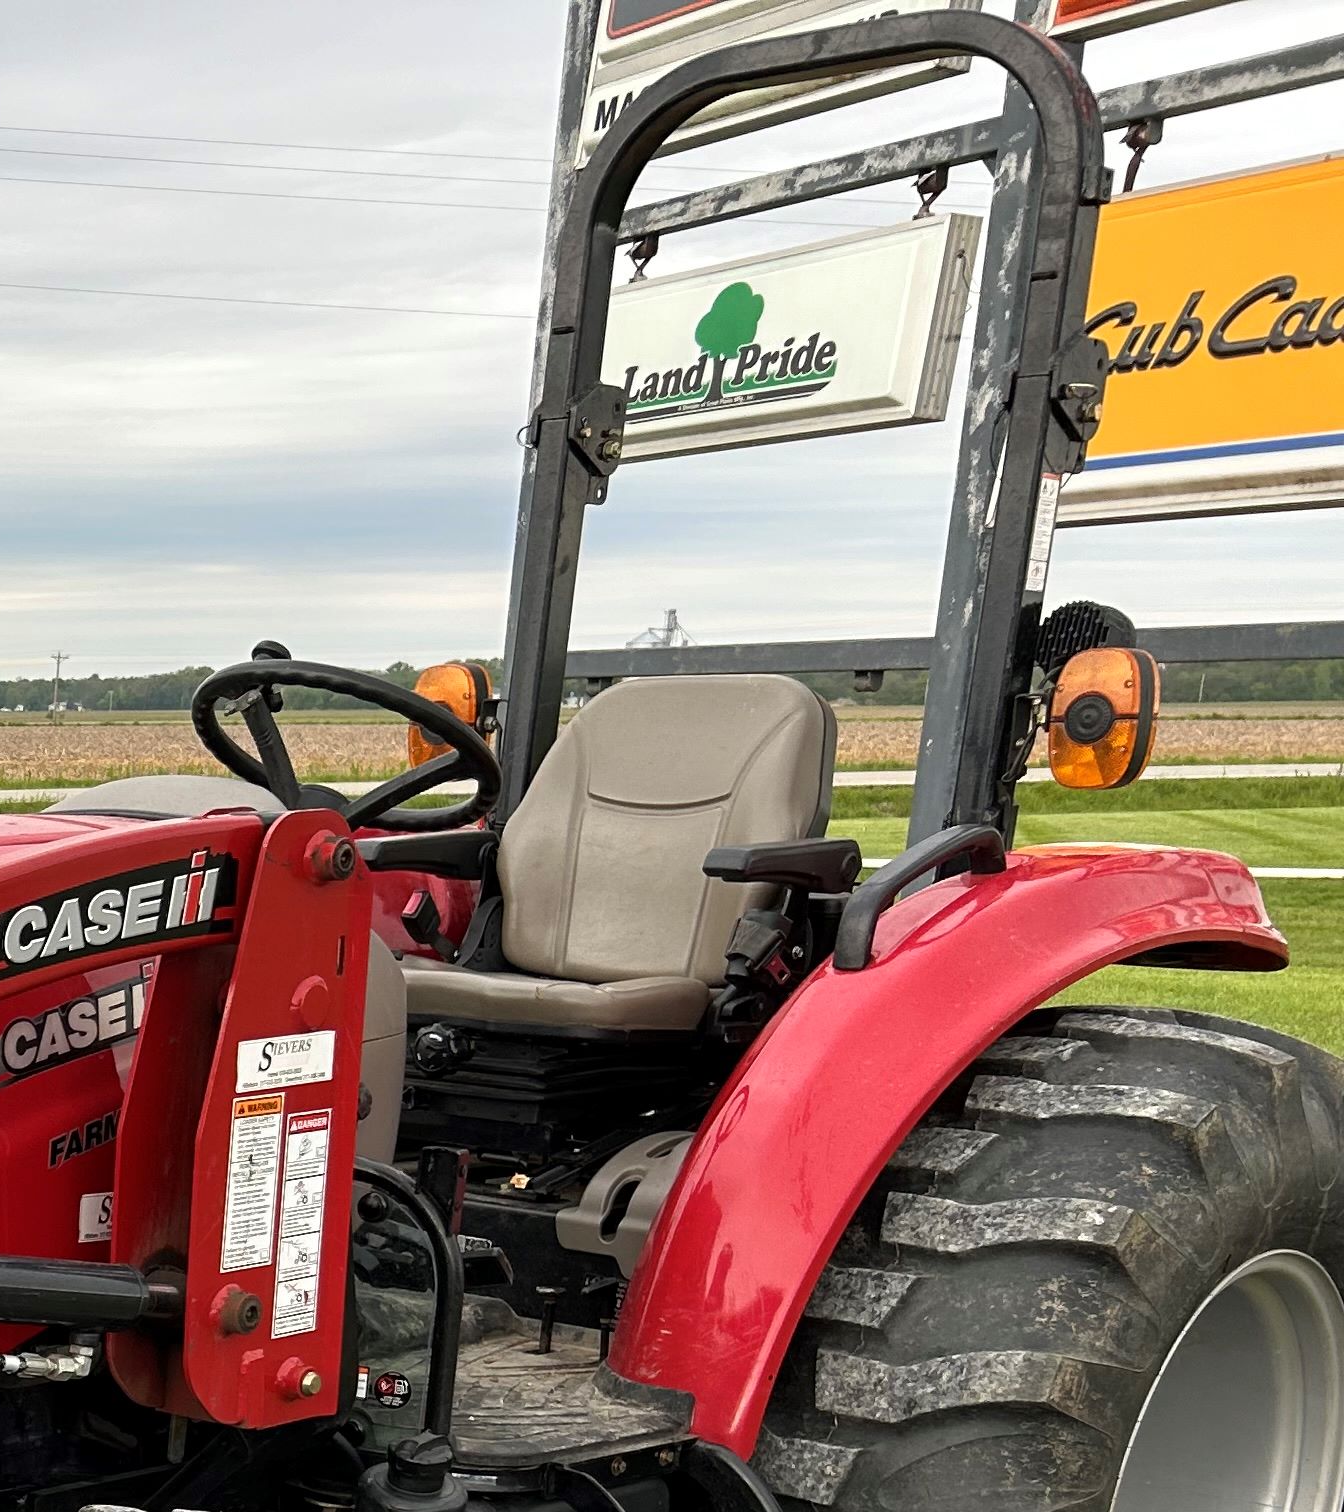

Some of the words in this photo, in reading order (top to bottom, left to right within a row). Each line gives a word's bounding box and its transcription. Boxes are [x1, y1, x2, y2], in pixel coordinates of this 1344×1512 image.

[625, 353, 708, 402] Land
[733, 332, 836, 385] Pride
[3, 880, 165, 966] CASE
[0, 989, 128, 1078] CASE
[257, 1038, 312, 1073] SIEVERS
[247, 1101, 278, 1114] WARNING
[297, 1116, 328, 1129] DANGER
